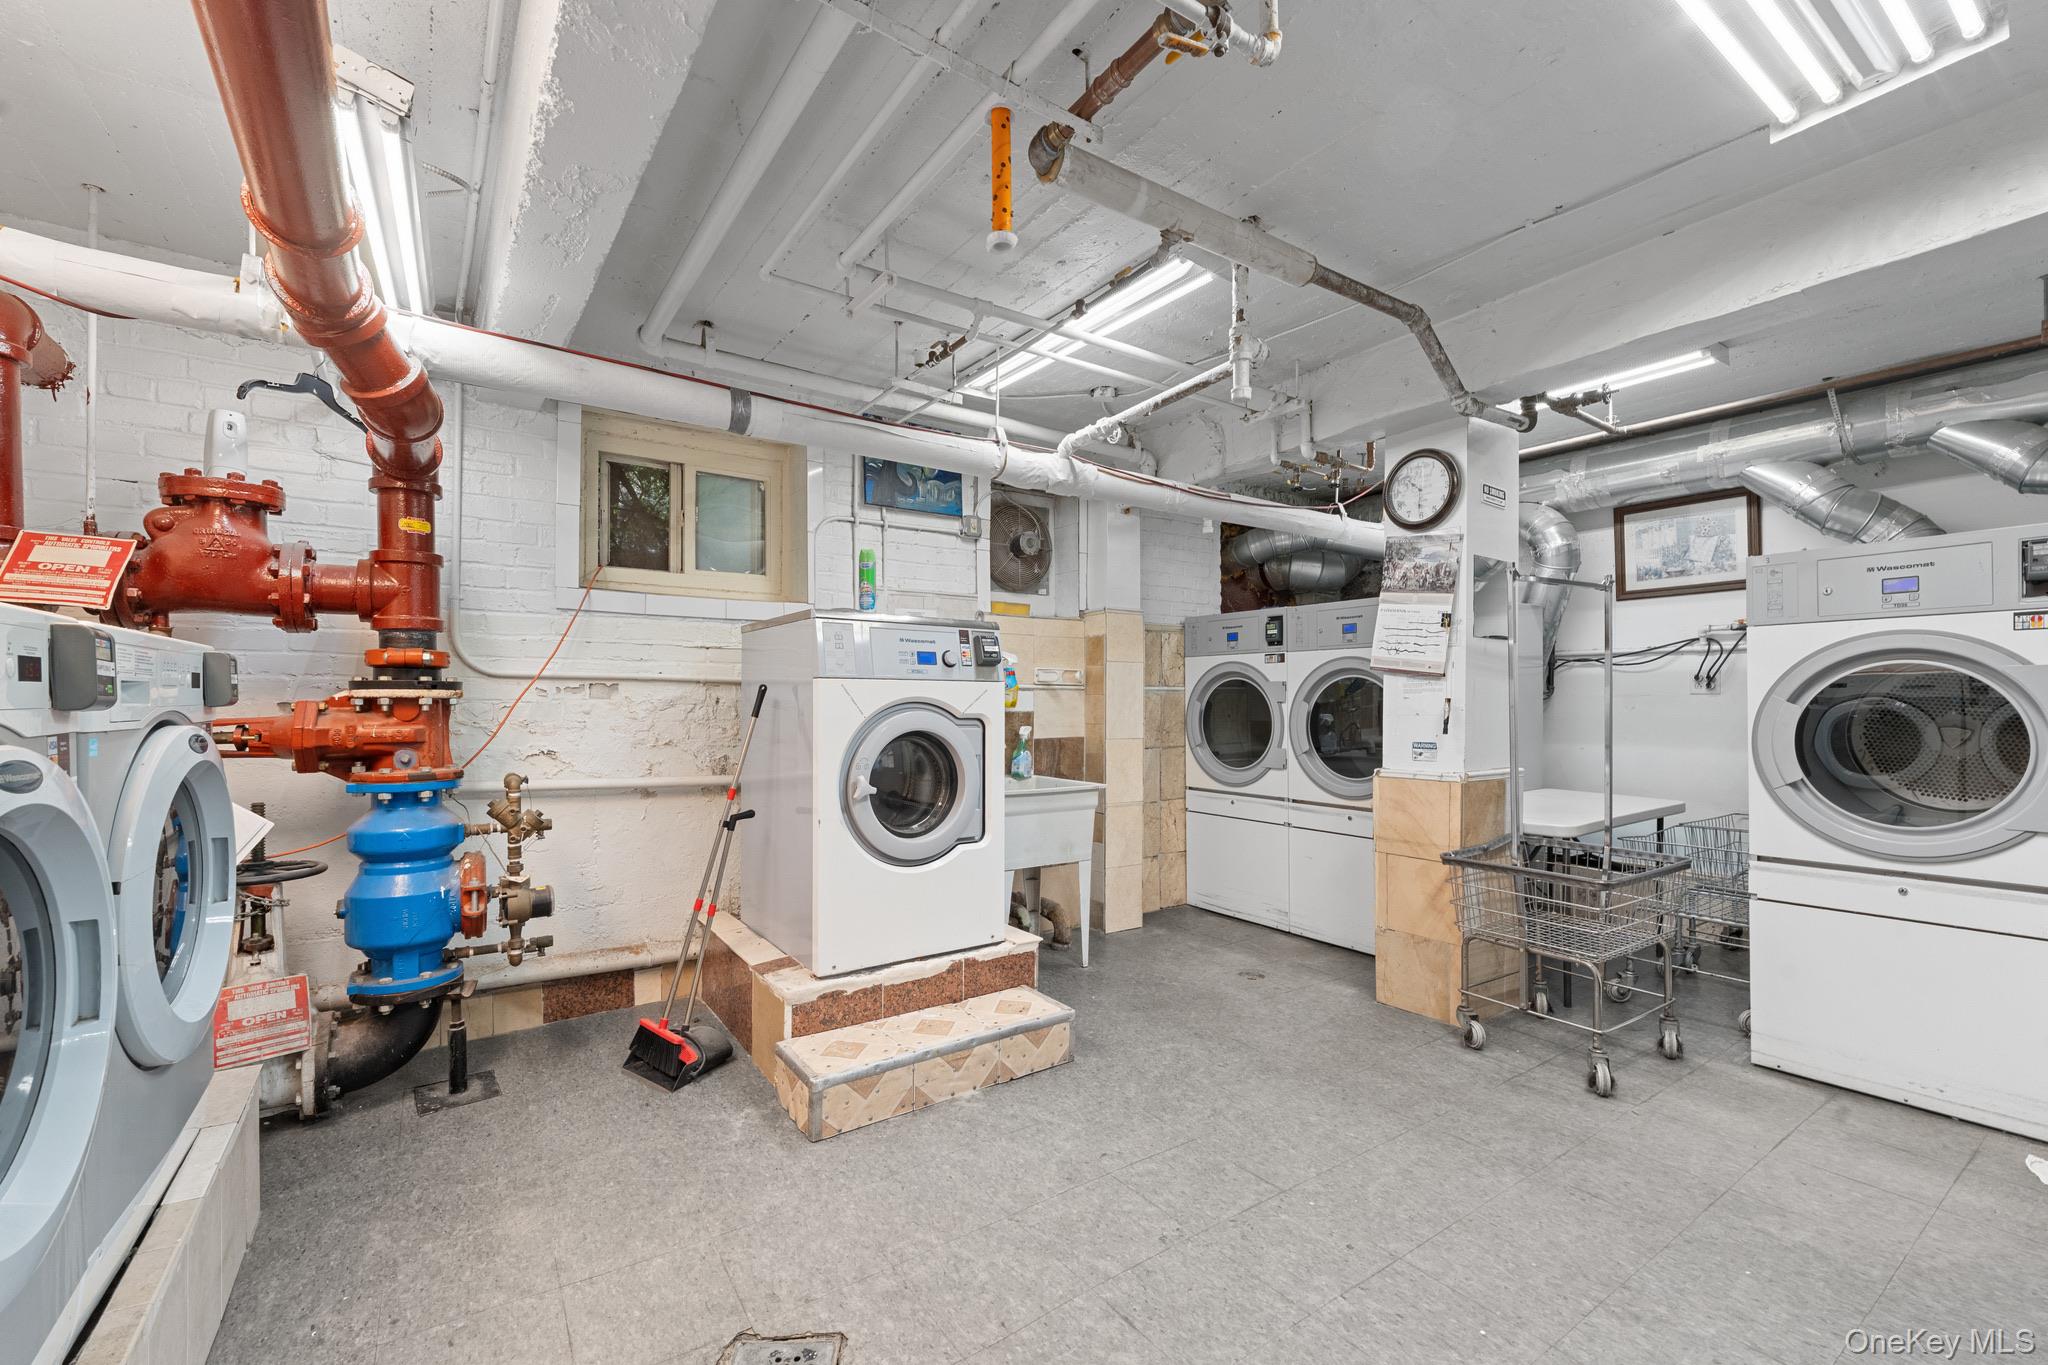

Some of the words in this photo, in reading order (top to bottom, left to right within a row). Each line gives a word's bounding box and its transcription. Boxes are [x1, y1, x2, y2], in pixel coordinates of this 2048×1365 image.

[43, 541, 82, 549] AUTOMATIC
[38, 562, 90, 573] OPEN
[1876, 561, 1936, 572] Wascomat
[241, 1010, 287, 1026] OPEN
